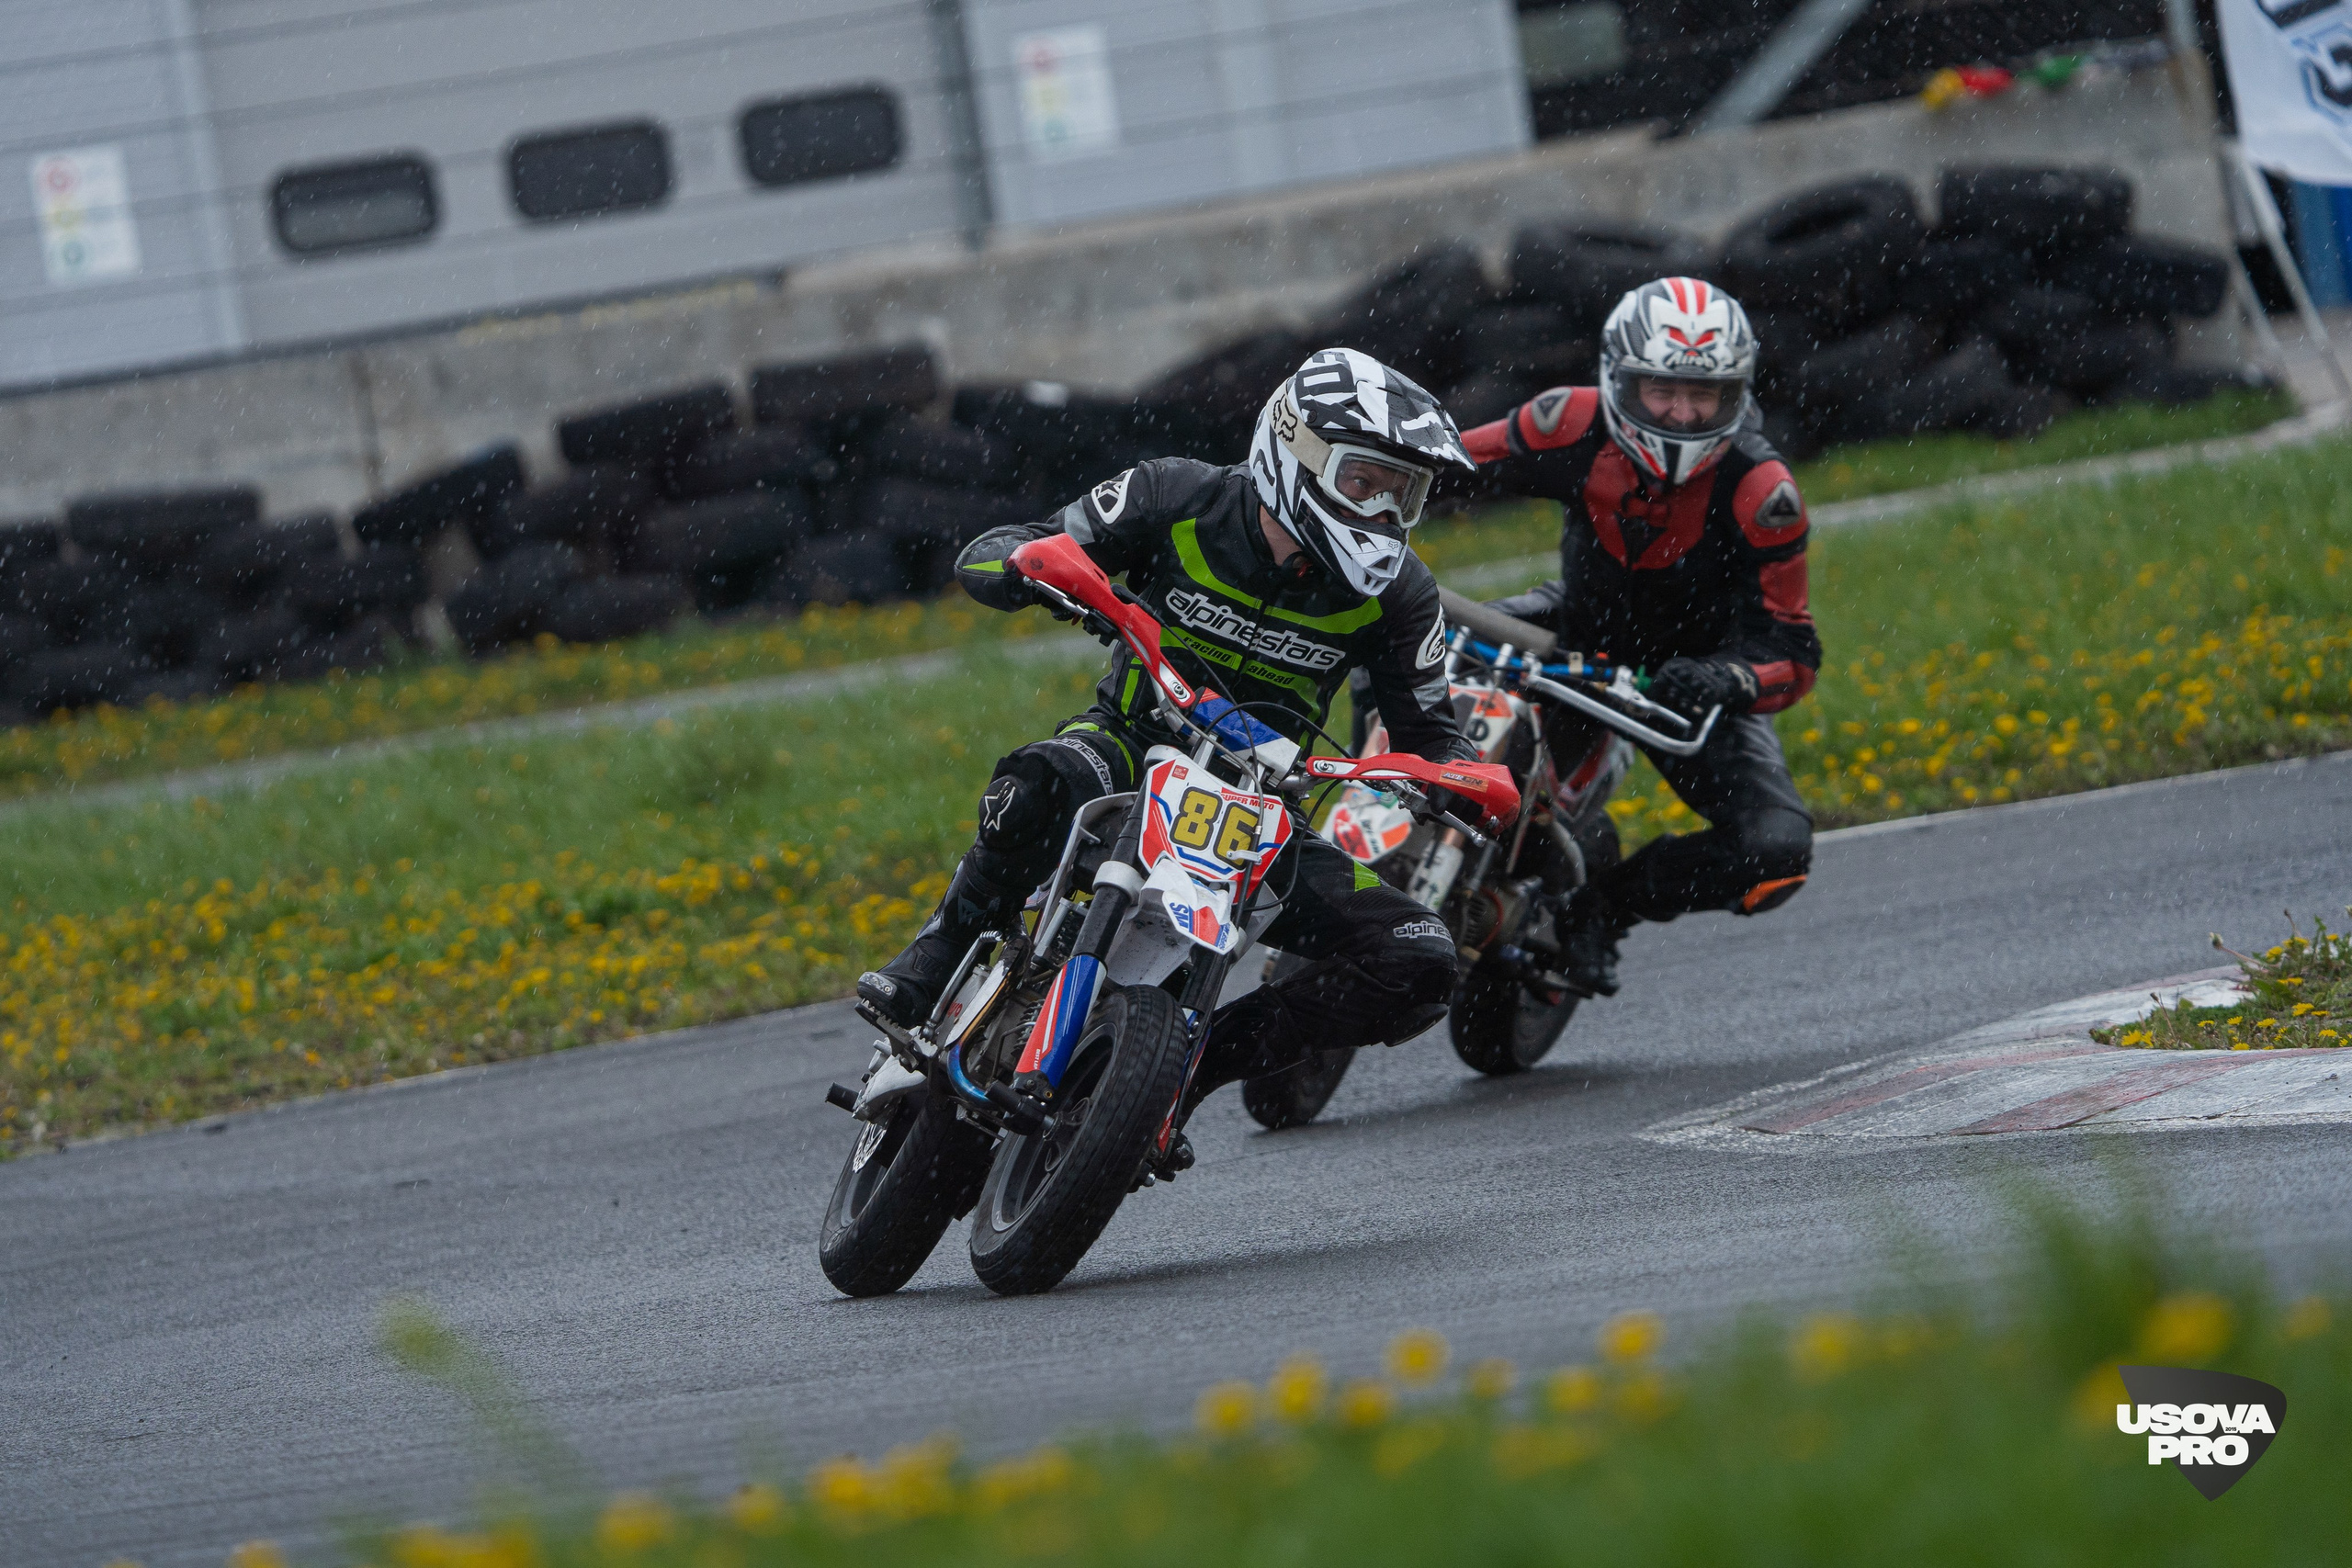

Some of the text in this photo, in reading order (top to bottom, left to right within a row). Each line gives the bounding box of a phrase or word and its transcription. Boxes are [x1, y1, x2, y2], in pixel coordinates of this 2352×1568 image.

[1167, 588, 1345, 669] alpinestars
[1183, 636, 1296, 685] racing ahead
[1221, 794, 1274, 810] SUPER MTO
[1170, 786, 1261, 871] 86
[1169, 902, 1189, 929] SM
